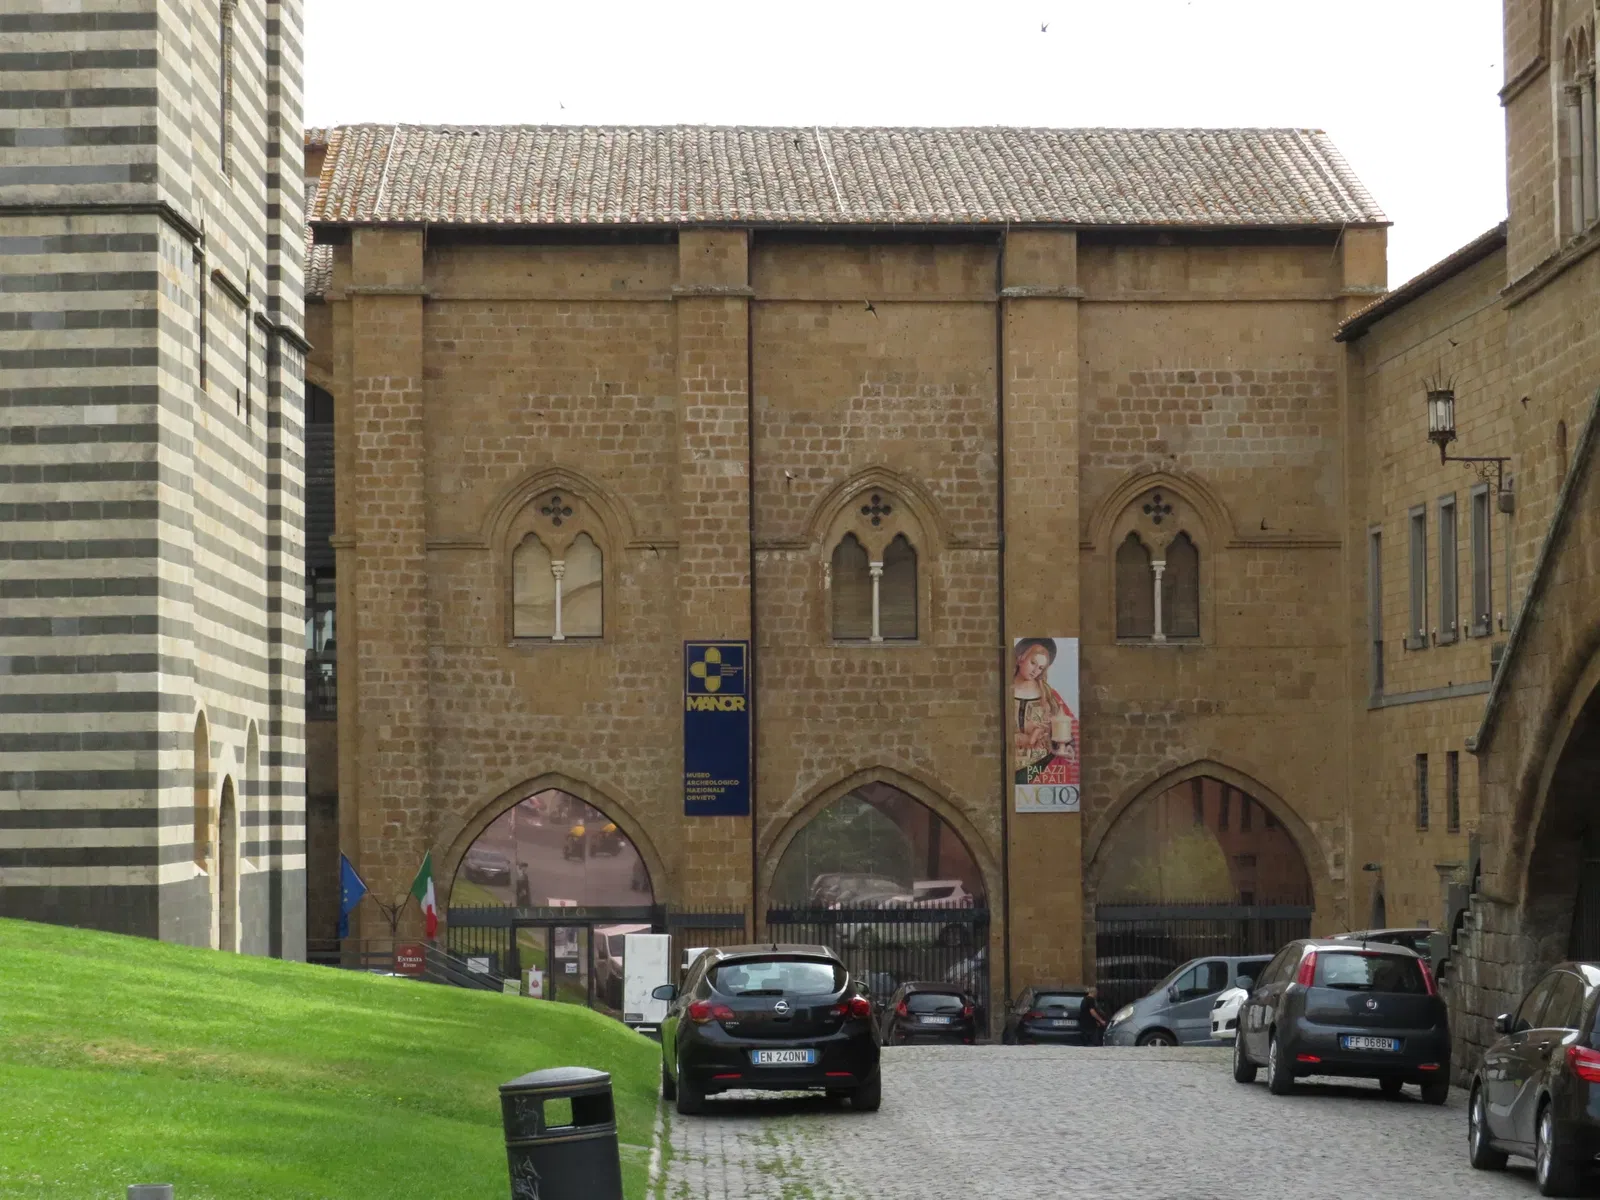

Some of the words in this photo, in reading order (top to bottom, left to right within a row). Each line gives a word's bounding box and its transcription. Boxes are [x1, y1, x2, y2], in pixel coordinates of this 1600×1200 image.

[686, 696, 746, 712] MANOR
[1026, 765, 1066, 775] PALAZZI
[1027, 774, 1066, 784] PAPALI
[1349, 1036, 1361, 1046] FF
[760, 1051, 773, 1063] EN
[776, 1051, 807, 1062] 240NW
